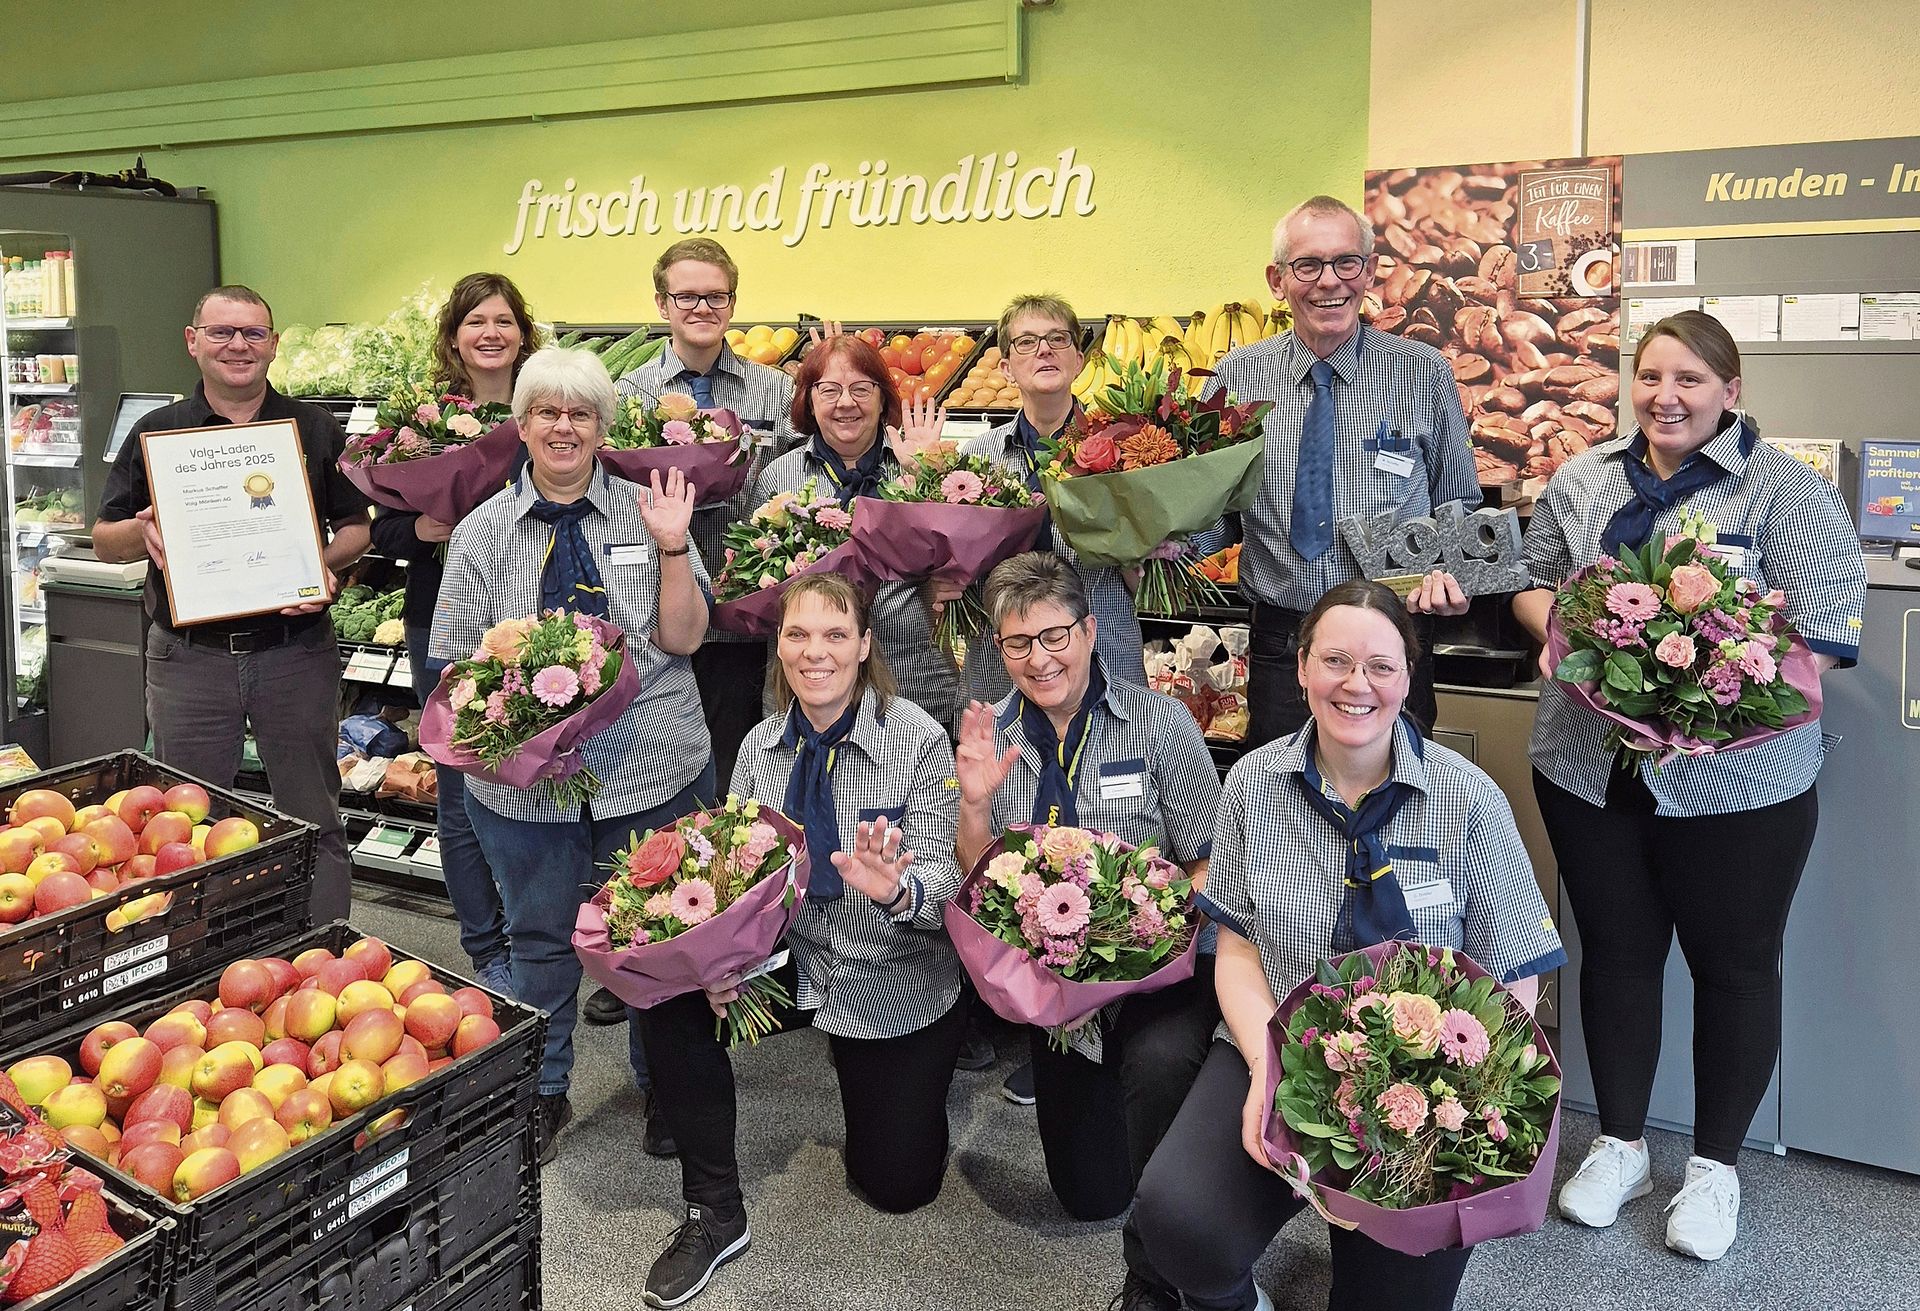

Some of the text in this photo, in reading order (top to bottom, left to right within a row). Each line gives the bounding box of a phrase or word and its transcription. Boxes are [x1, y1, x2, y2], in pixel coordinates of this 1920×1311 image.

[1526, 184, 1547, 202] ZEIT
[1550, 178, 1571, 197] FÜR
[1704, 167, 1849, 202] Kunden
[504, 146, 1097, 255] frisch und fründlich
[1535, 199, 1595, 237] Kaffee
[175, 453, 276, 474] des Jahres 2025
[189, 443, 257, 460] Volg-Laden
[1868, 446, 1920, 458] Sammel
[1869, 457, 1892, 468] und
[1897, 505, 1904, 513] 2
[298, 586, 321, 597] Volg
[63, 942, 155, 989] LL 6410 IFCO
[62, 998, 74, 1010] LL
[131, 963, 154, 978] IFCO
[313, 1157, 397, 1219] LL 6410 IFCO
[313, 1178, 395, 1241] LL 6410 IFCO
